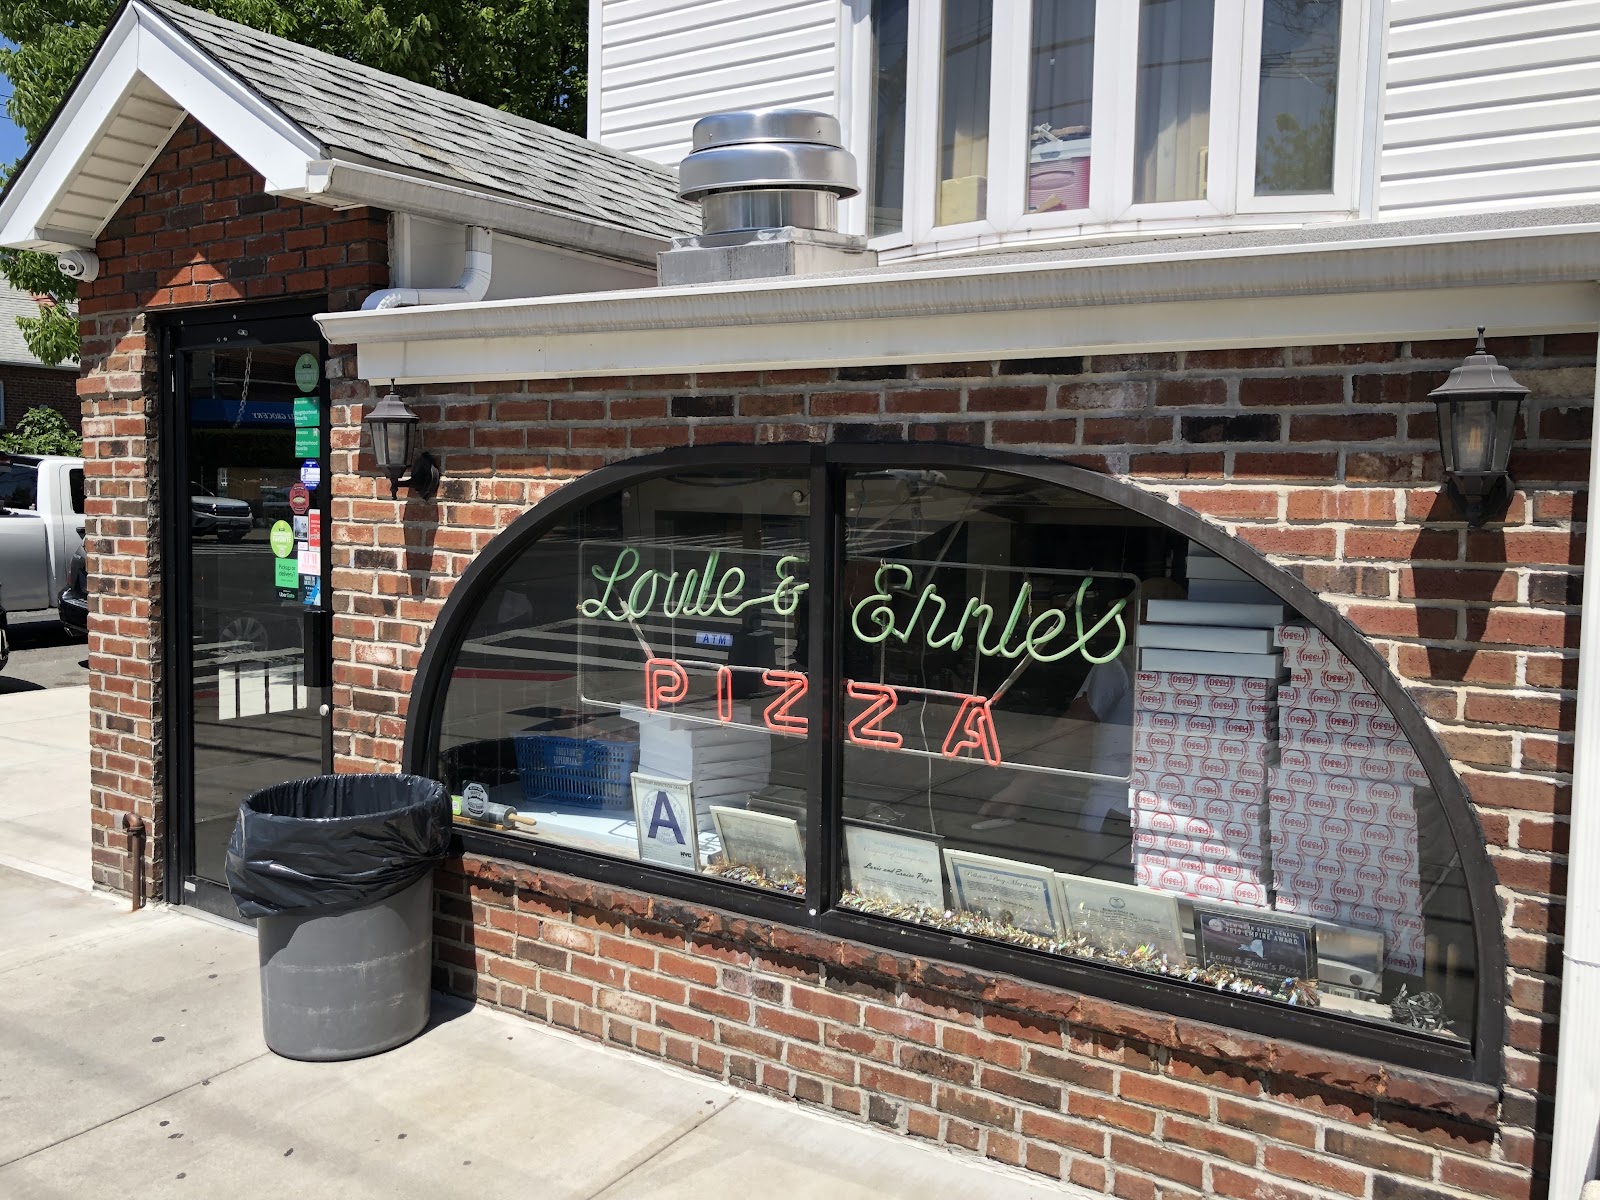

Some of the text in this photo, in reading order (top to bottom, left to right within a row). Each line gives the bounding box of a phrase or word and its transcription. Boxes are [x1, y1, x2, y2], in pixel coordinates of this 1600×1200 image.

[774, 555, 810, 616] &
[702, 634, 726, 645] ATM
[644, 658, 1001, 766] PIZZA
[648, 791, 686, 845] A
[1244, 930, 1270, 940] EMPIRE
[1274, 936, 1298, 945] AWARD
[1234, 956, 1242, 964] &
